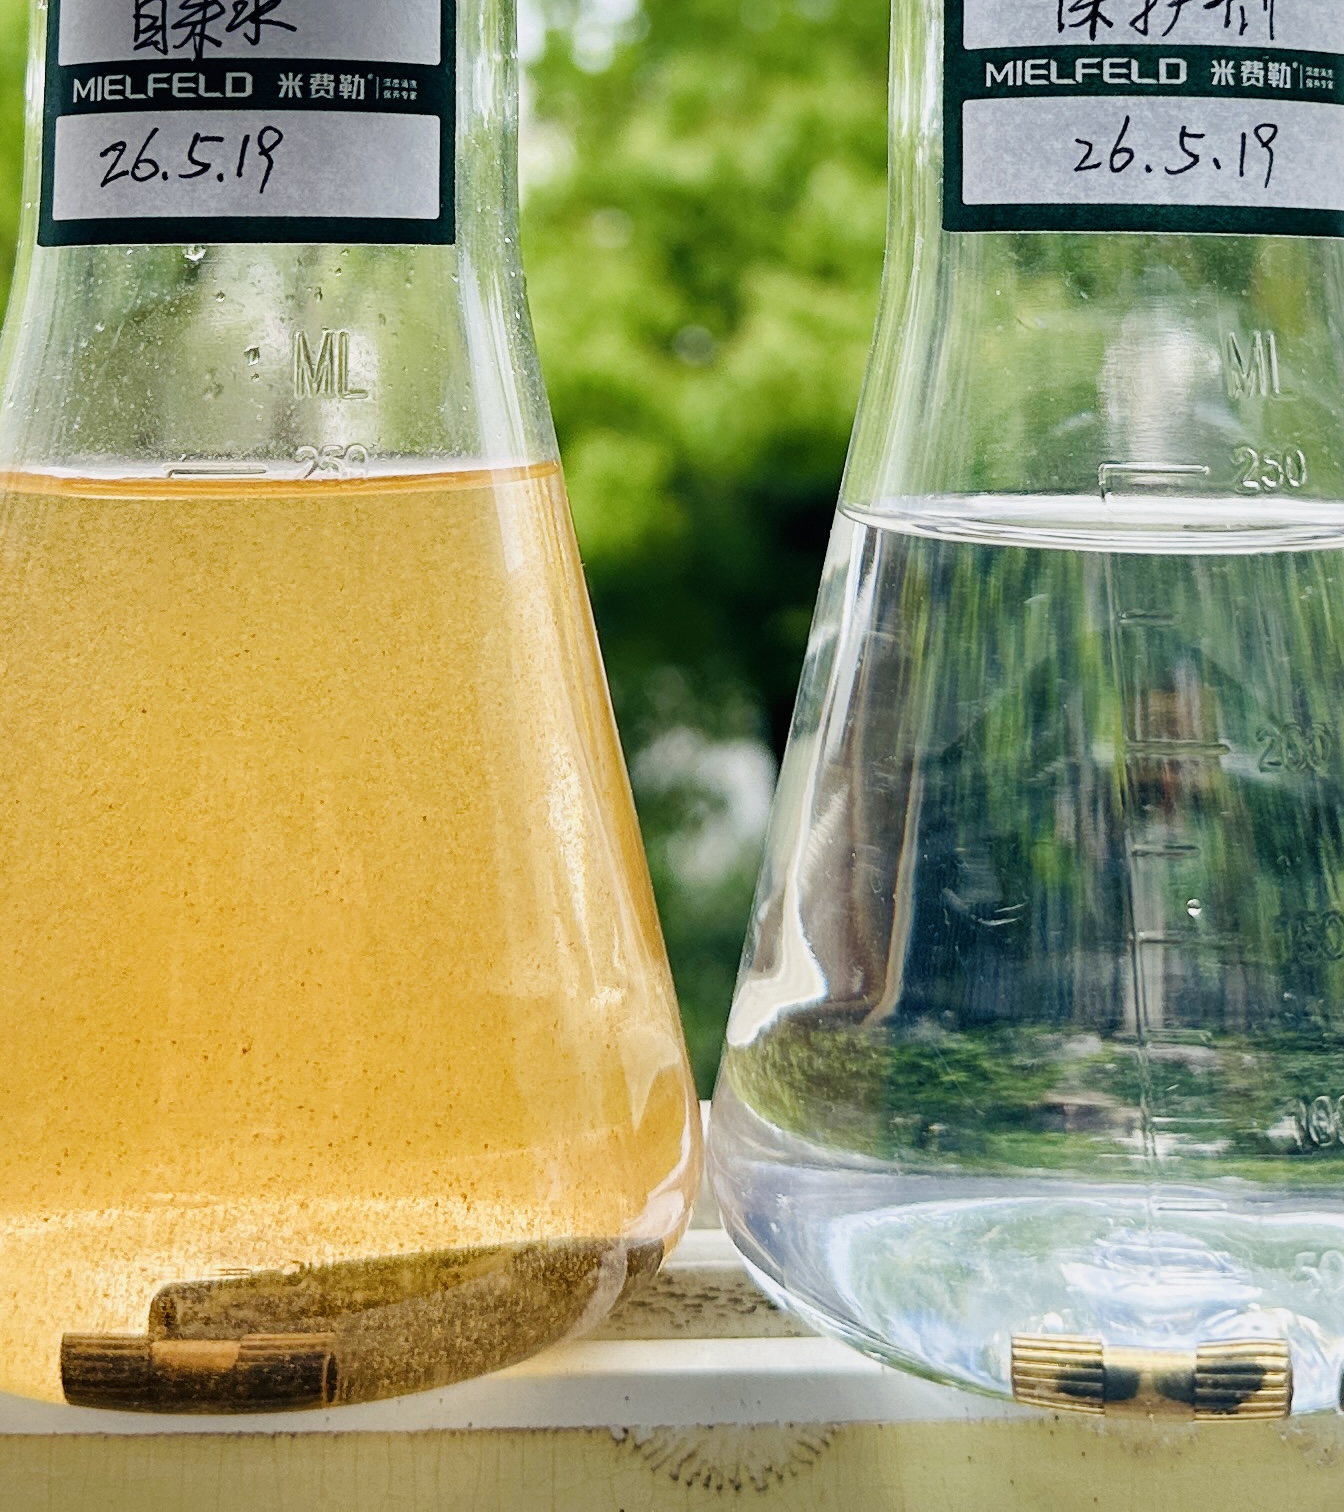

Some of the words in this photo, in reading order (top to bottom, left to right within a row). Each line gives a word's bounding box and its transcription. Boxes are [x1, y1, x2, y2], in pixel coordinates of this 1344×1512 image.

[72, 70, 254, 103] MIELFELD
[277, 72, 365, 101] 米费勒
[985, 57, 1188, 88] MIELFELD
[1210, 59, 1291, 89] 米费勒
[100, 125, 284, 194] 26.5.19
[1073, 114, 1278, 188] 26.5.19
[293, 330, 369, 399] ML
[1230, 446, 1306, 493] 250
